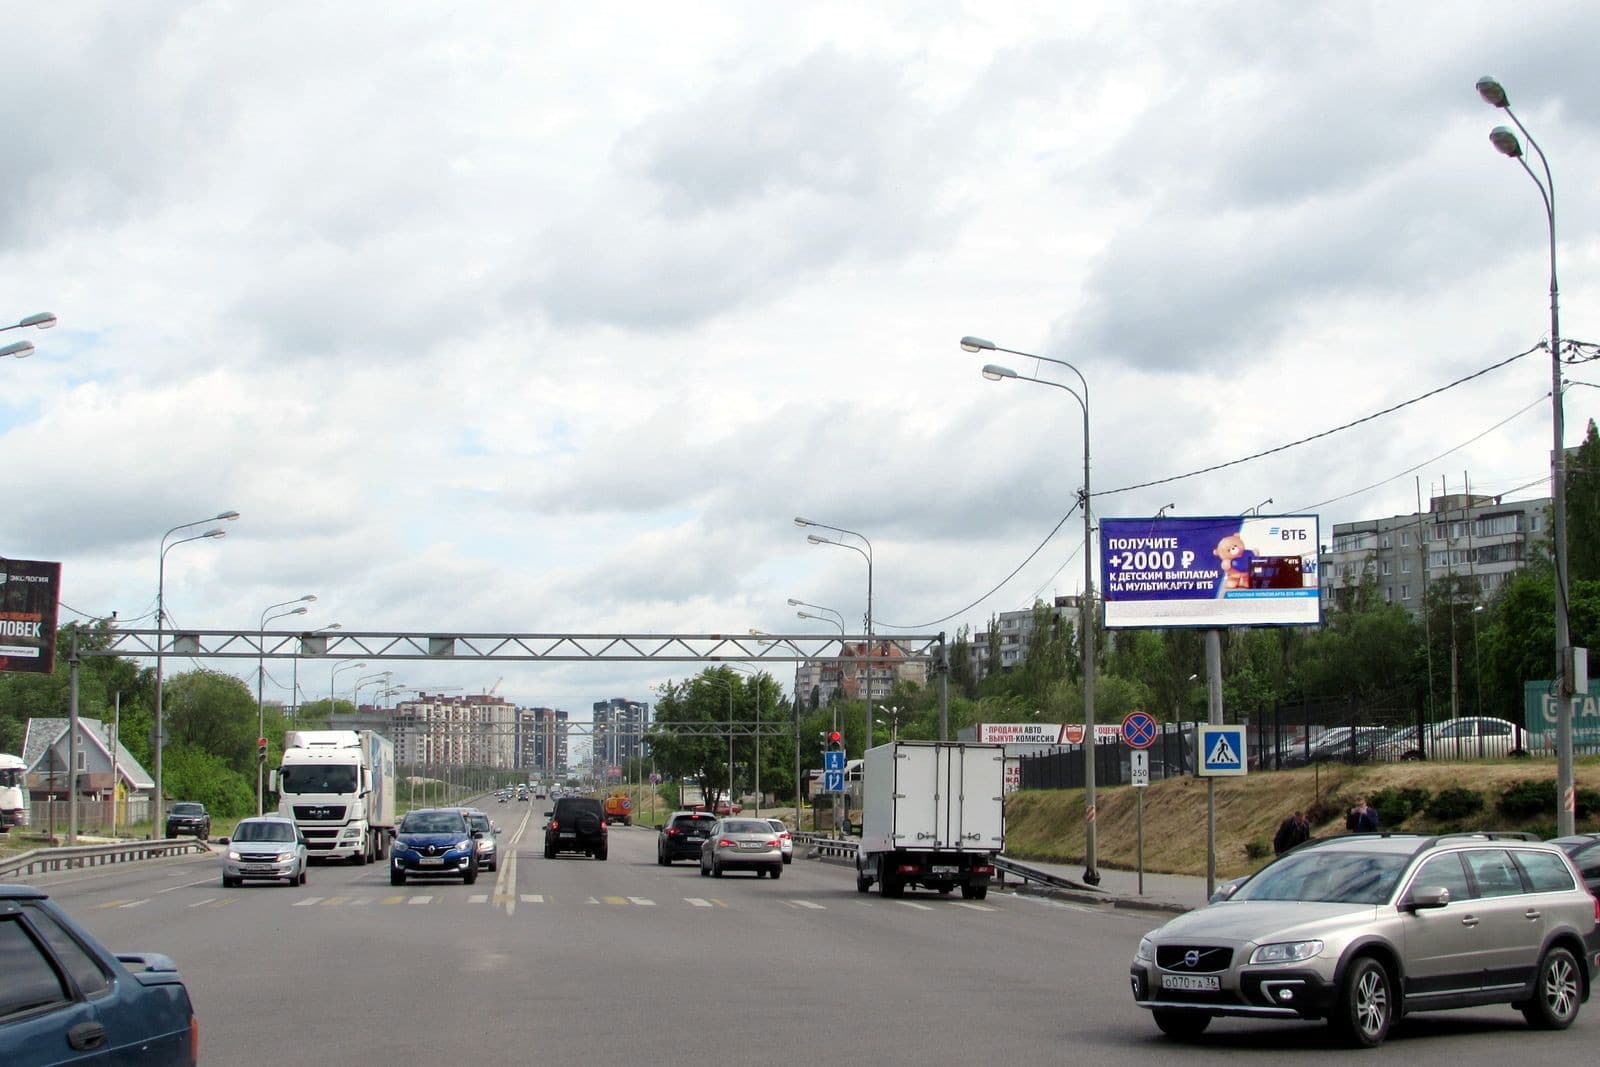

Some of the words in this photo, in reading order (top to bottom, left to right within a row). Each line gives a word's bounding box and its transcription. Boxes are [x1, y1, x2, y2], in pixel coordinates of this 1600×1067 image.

[1281, 529, 1307, 540] ВТБ
[1109, 538, 1178, 550] ПОЛУЧИТЕ
[1109, 551, 1175, 570] +2000
[1109, 572, 1117, 581] К
[1118, 571, 1163, 582] ДЕТСКИМ
[1165, 570, 1218, 580] ВЫПЛАТАМ
[1110, 583, 1125, 592] НА
[1126, 581, 1194, 591] МУЛЬТИКАРТУ
[1196, 581, 1214, 590] ВТБ
[988, 726, 1023, 734] ПРОДАЖА
[1024, 726, 1042, 734] АВТО
[1015, 735, 1055, 743] КОМИССИЯ
[1132, 769, 1148, 777] 250
